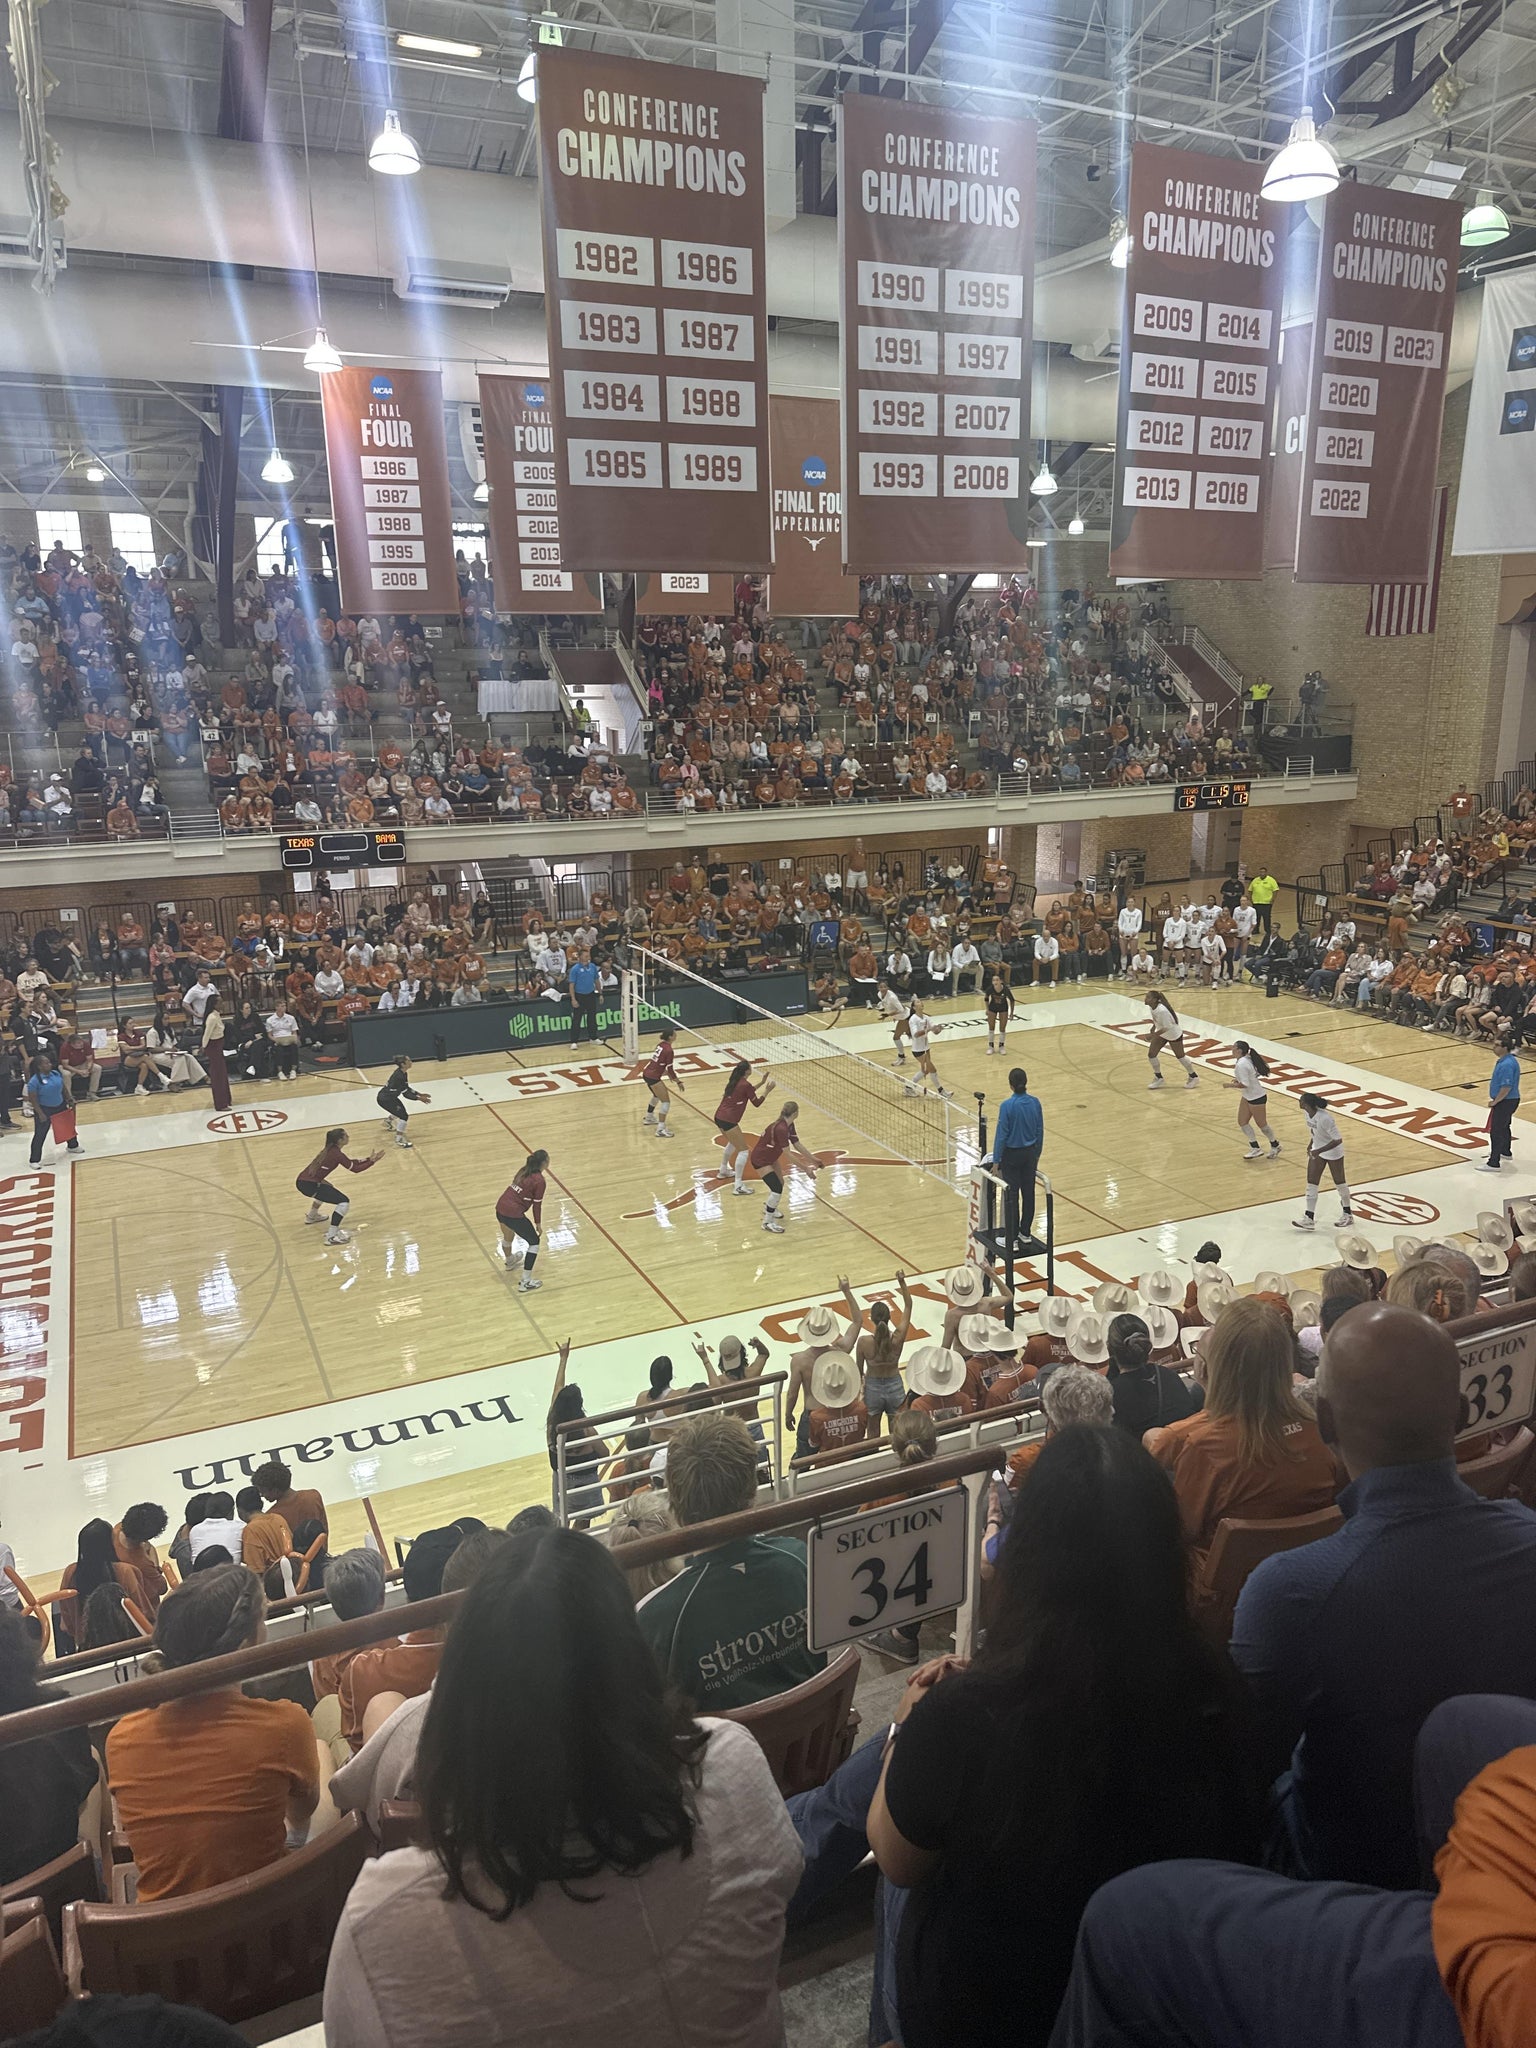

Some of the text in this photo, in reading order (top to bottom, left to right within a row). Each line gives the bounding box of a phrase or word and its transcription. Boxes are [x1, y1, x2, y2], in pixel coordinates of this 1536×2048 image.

[583, 89, 719, 140] CONFERENCE
[557, 129, 746, 196] CHAMPIONS
[884, 132, 1000, 177] CONFERENCE
[861, 170, 1020, 229] CHAMPIONS
[1165, 178, 1259, 221] CONFERENCE
[1143, 211, 1275, 268] CHAMPIONS
[1352, 211, 1436, 249] CONFERENCE
[575, 242, 736, 285] 1982 1986
[1333, 242, 1448, 293] CHAMPIONS
[871, 271, 1009, 309] 1990 1995
[579, 312, 738, 352] 1983 1987
[1143, 303, 1260, 341] 2009 2014
[875, 337, 1009, 371] 1991 1997
[1334, 328, 1435, 362] 2019 2023
[372, 387, 393, 395] NCAA
[1145, 361, 1256, 397] 2011 2015
[581, 381, 740, 418] 1984 1988
[1329, 382, 1370, 408] 2020
[369, 403, 401, 417] FINAL
[522, 410, 552, 424] FINAL
[872, 400, 1010, 432] 1992 2007
[360, 419, 414, 448] FOUR
[1140, 421, 1252, 452] 2012 2017
[1327, 435, 1363, 460] 2021
[373, 461, 406, 476] 1986
[585, 449, 742, 482] 1985 1989
[804, 470, 826, 479] NCAA
[872, 461, 1009, 491] 1993 2008
[376, 489, 408, 503] 1987
[527, 493, 556, 507] 2010
[774, 490, 843, 514] FINAL FOU
[1136, 477, 1249, 506] 2013 2018
[1320, 488, 1361, 512] 2022
[378, 517, 411, 532] 1988
[529, 520, 558, 533] 2012
[775, 516, 840, 533] APPEARANC
[381, 545, 413, 559] 1995
[531, 547, 560, 561] 2013
[382, 572, 417, 586] 2008
[533, 574, 562, 587] 2014
[670, 575, 699, 589] 2023
[1456, 798, 1467, 808] T
[287, 834, 397, 848] TEXAS BAMA
[638, 1001, 681, 1021] Bank
[966, 1180, 981, 1267] TEXA
[1460, 1335, 1527, 1369] SECTION
[1463, 1364, 1513, 1429] 33
[824, 1415, 858, 1428] LONGHORN
[836, 1504, 945, 1554] SECTION
[848, 1541, 933, 1628] 34
